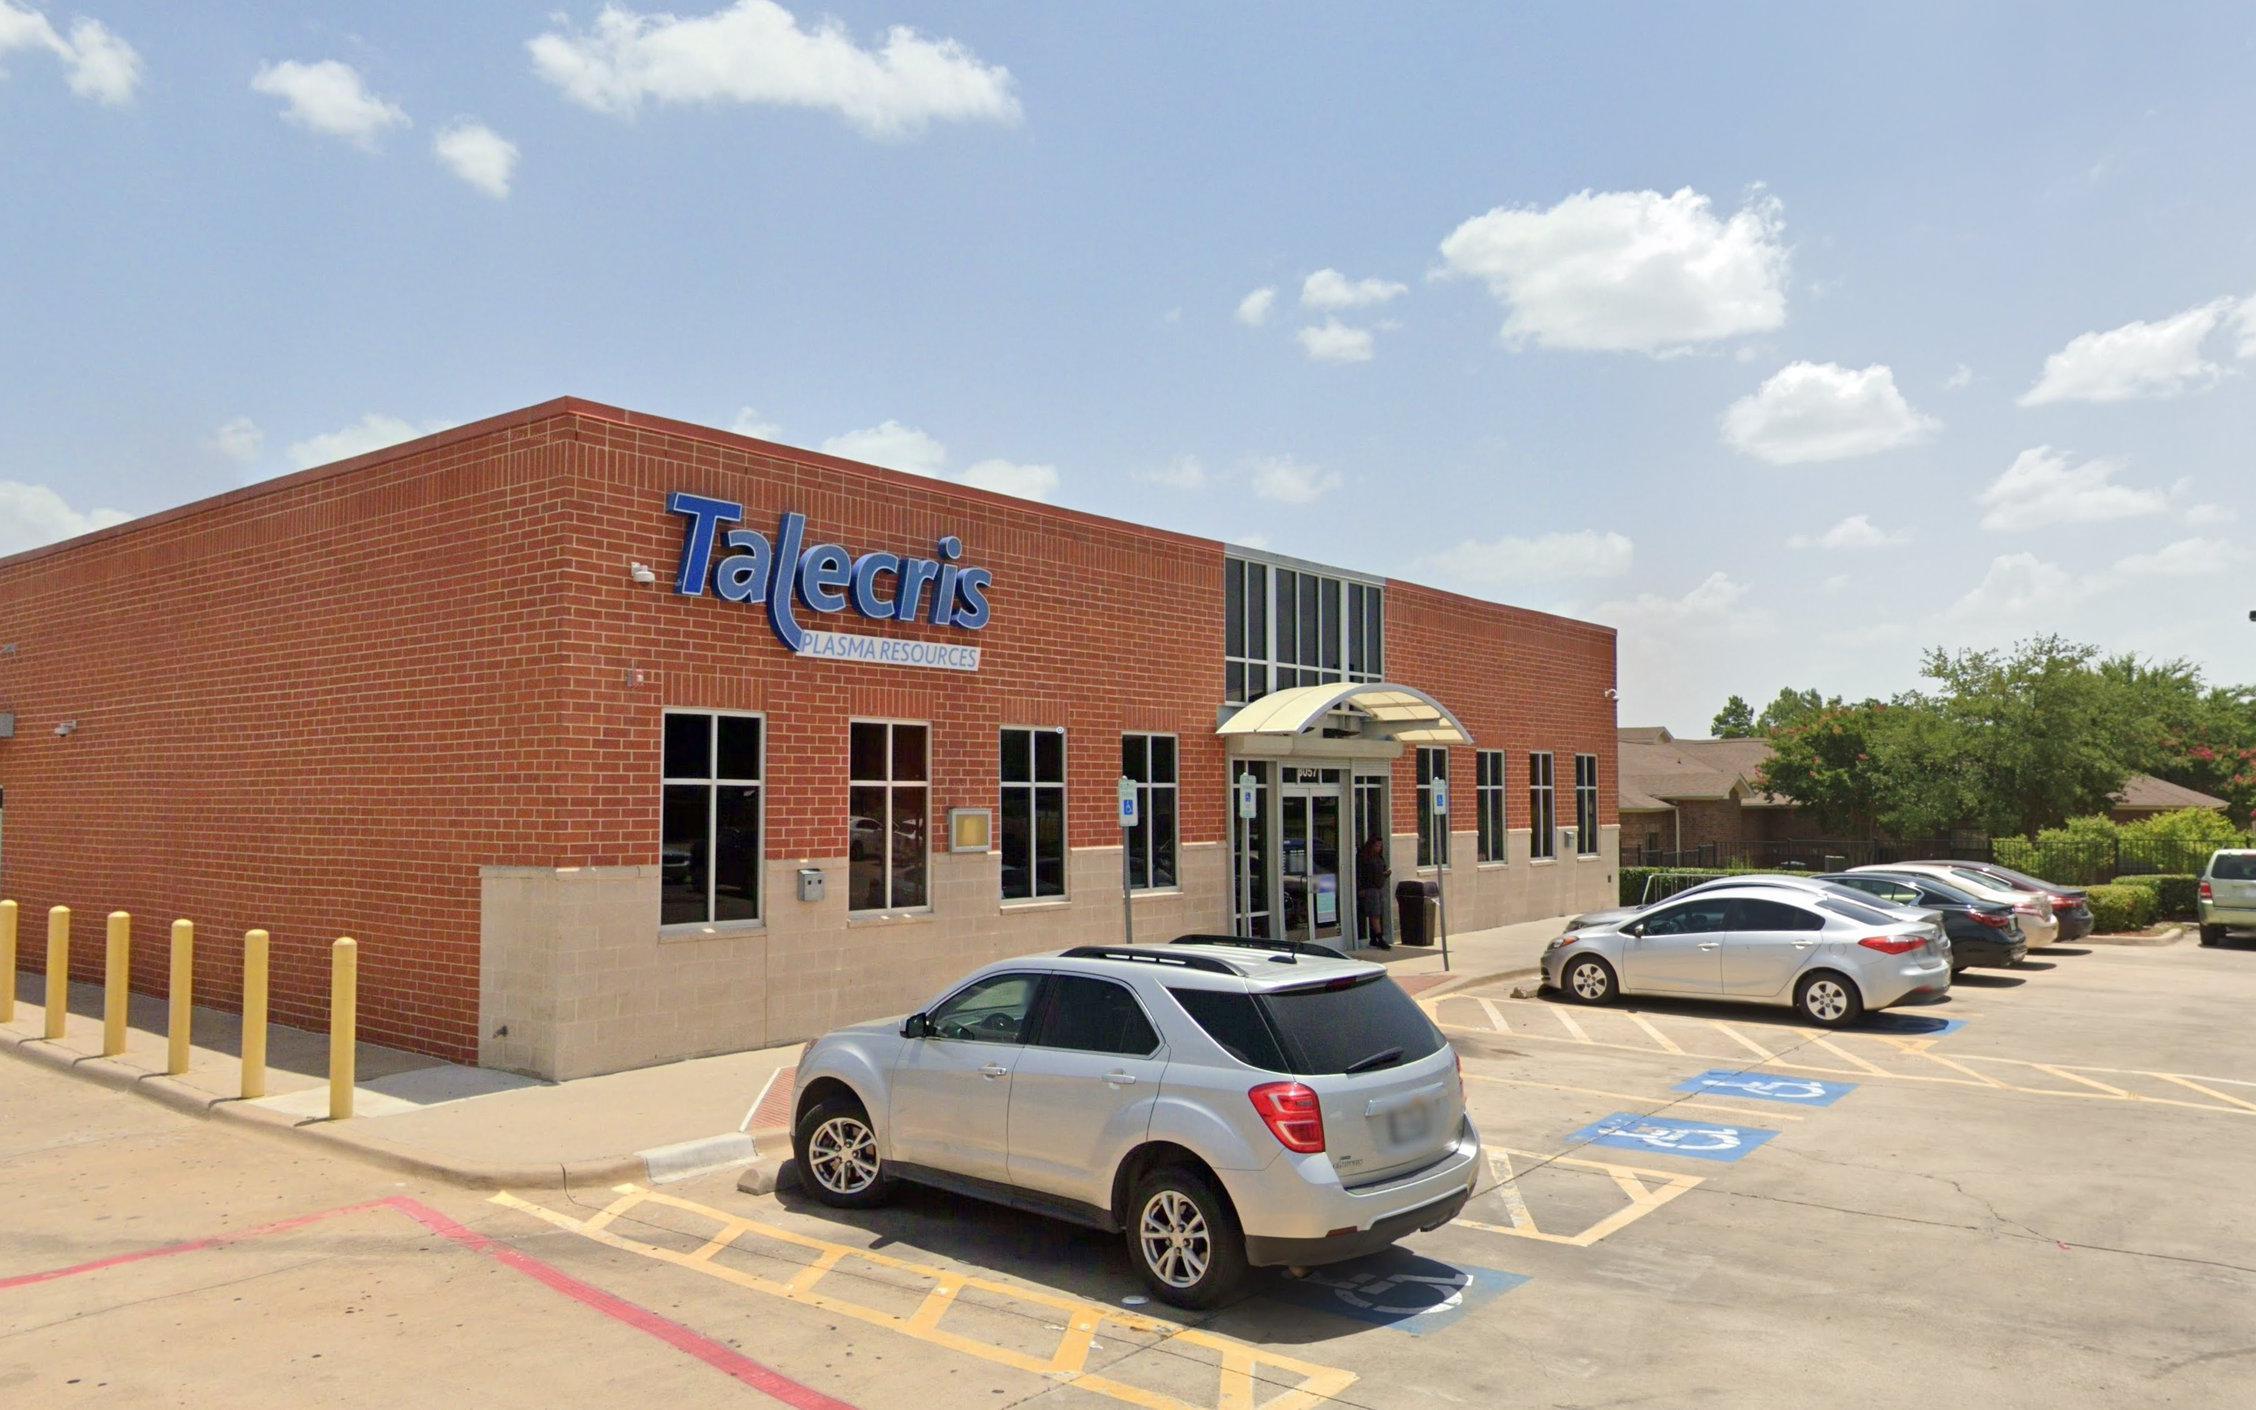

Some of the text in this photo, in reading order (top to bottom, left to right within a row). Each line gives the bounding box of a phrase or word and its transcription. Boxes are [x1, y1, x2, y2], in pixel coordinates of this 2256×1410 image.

[668, 491, 993, 655] Talecris
[801, 632, 977, 668] PLASMA RESOURCES
